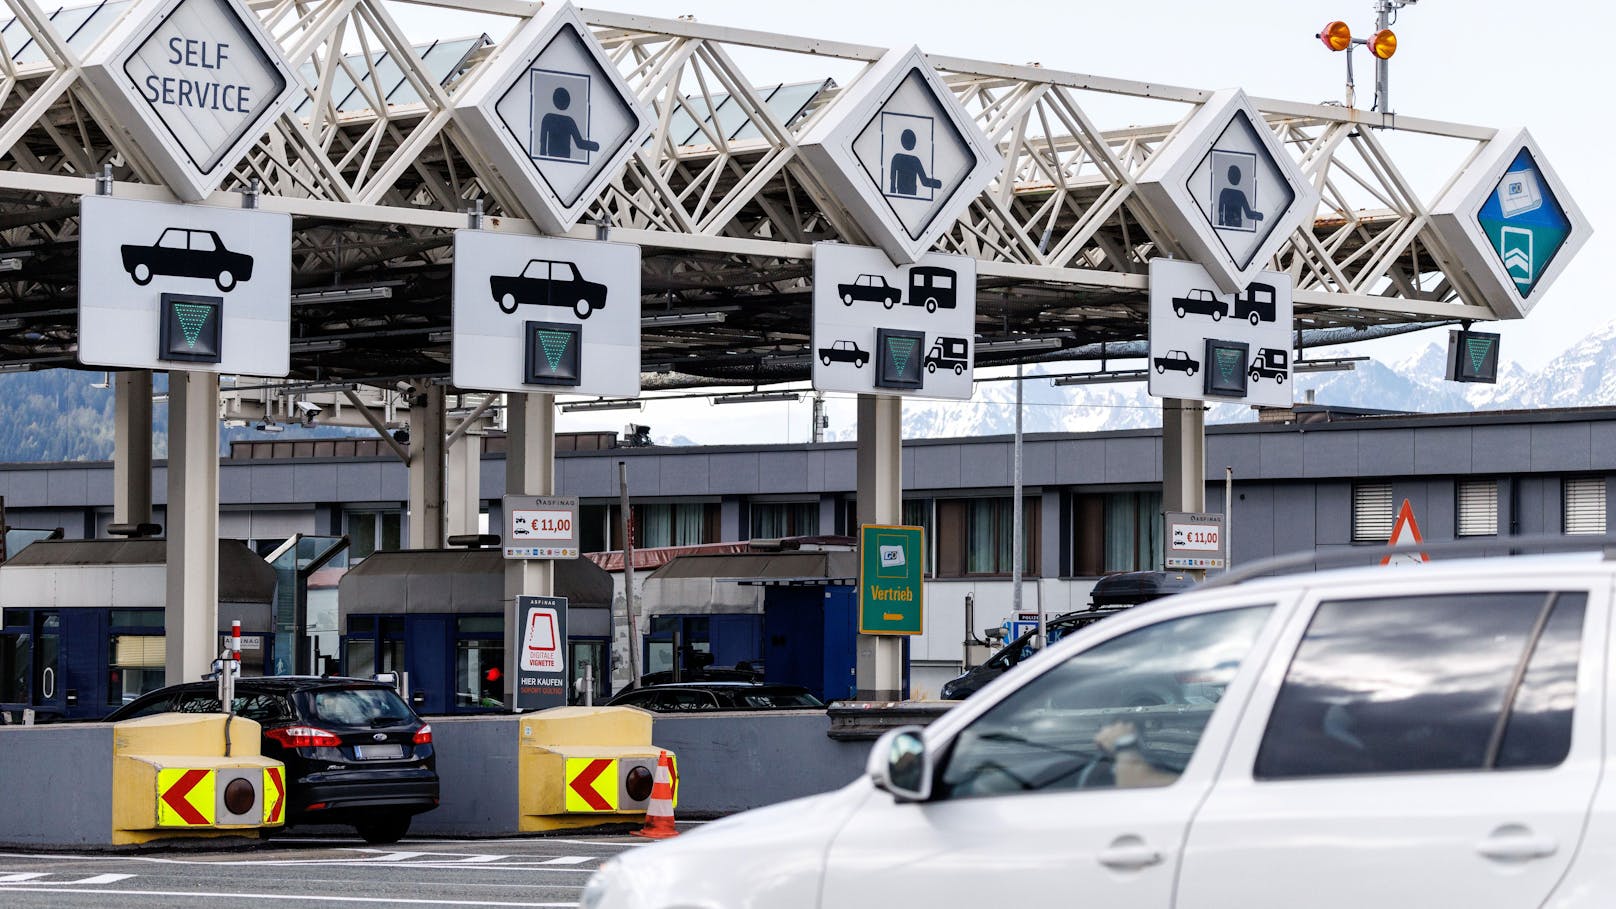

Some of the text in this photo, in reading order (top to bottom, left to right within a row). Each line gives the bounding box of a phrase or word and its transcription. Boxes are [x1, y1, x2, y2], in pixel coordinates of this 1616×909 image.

[169, 37, 229, 69] SELF
[145, 75, 250, 113] SERVICE
[531, 519, 570, 532] € 11,00
[1187, 532, 1217, 544] € 11,00
[871, 585, 912, 602] Vertrieb
[521, 677, 563, 687] HIER KAUFEN
